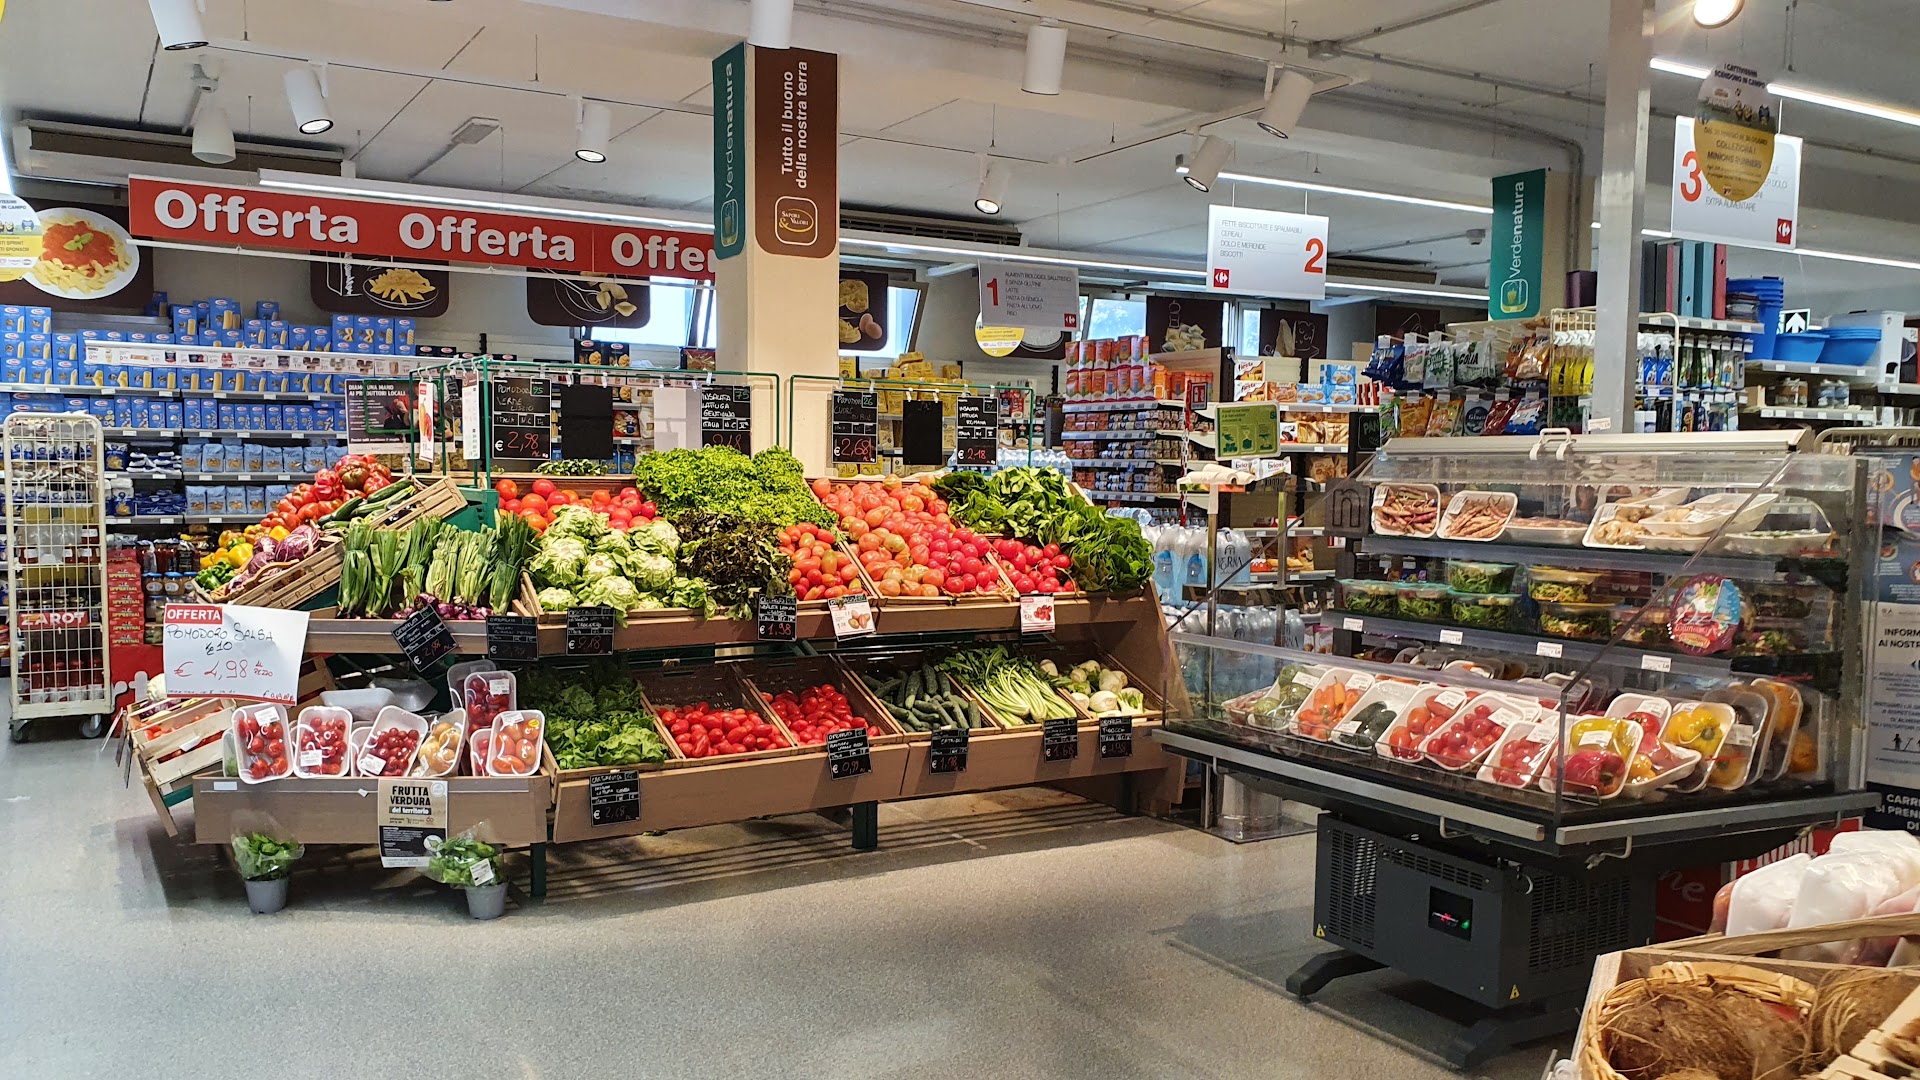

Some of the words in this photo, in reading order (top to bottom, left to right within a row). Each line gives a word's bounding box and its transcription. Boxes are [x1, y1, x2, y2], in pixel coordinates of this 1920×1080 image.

[796, 62, 808, 97] terra
[782, 71, 794, 120] buono
[725, 62, 733, 198] Verdenatura
[782, 124, 793, 133] il
[796, 101, 808, 149] nostra
[782, 138, 793, 175] Tutto
[795, 154, 807, 189] della
[1680, 150, 1702, 202] 3
[154, 189, 358, 245] Offerta
[1221, 220, 1237, 228] FETTE
[1509, 181, 1525, 279] Verdenatura
[399, 212, 575, 262] Offerta
[1304, 237, 1324, 274] 2
[986, 277, 999, 306] 1
[495, 439, 504, 451] €
[507, 431, 538, 452] 2,98
[834, 446, 841, 457] €
[958, 449, 964, 459] €
[166, 608, 221, 620] OFFERTA
[165, 624, 228, 640] POMODORO
[233, 622, 273, 641] SALSA
[759, 625, 765, 634] €
[216, 641, 233, 652] 10
[568, 640, 575, 650] €
[1878, 639, 1888, 647] AI
[490, 645, 497, 654] €
[413, 655, 422, 665] €
[173, 661, 194, 678] €
[203, 659, 248, 681] 4,98
[1046, 748, 1051, 757] €
[1101, 745, 1106, 754] €
[833, 764, 838, 773] €
[932, 760, 937, 769] €
[392, 786, 429, 796] FRUTTA
[390, 796, 431, 806] VERDURA
[593, 810, 600, 819] €
